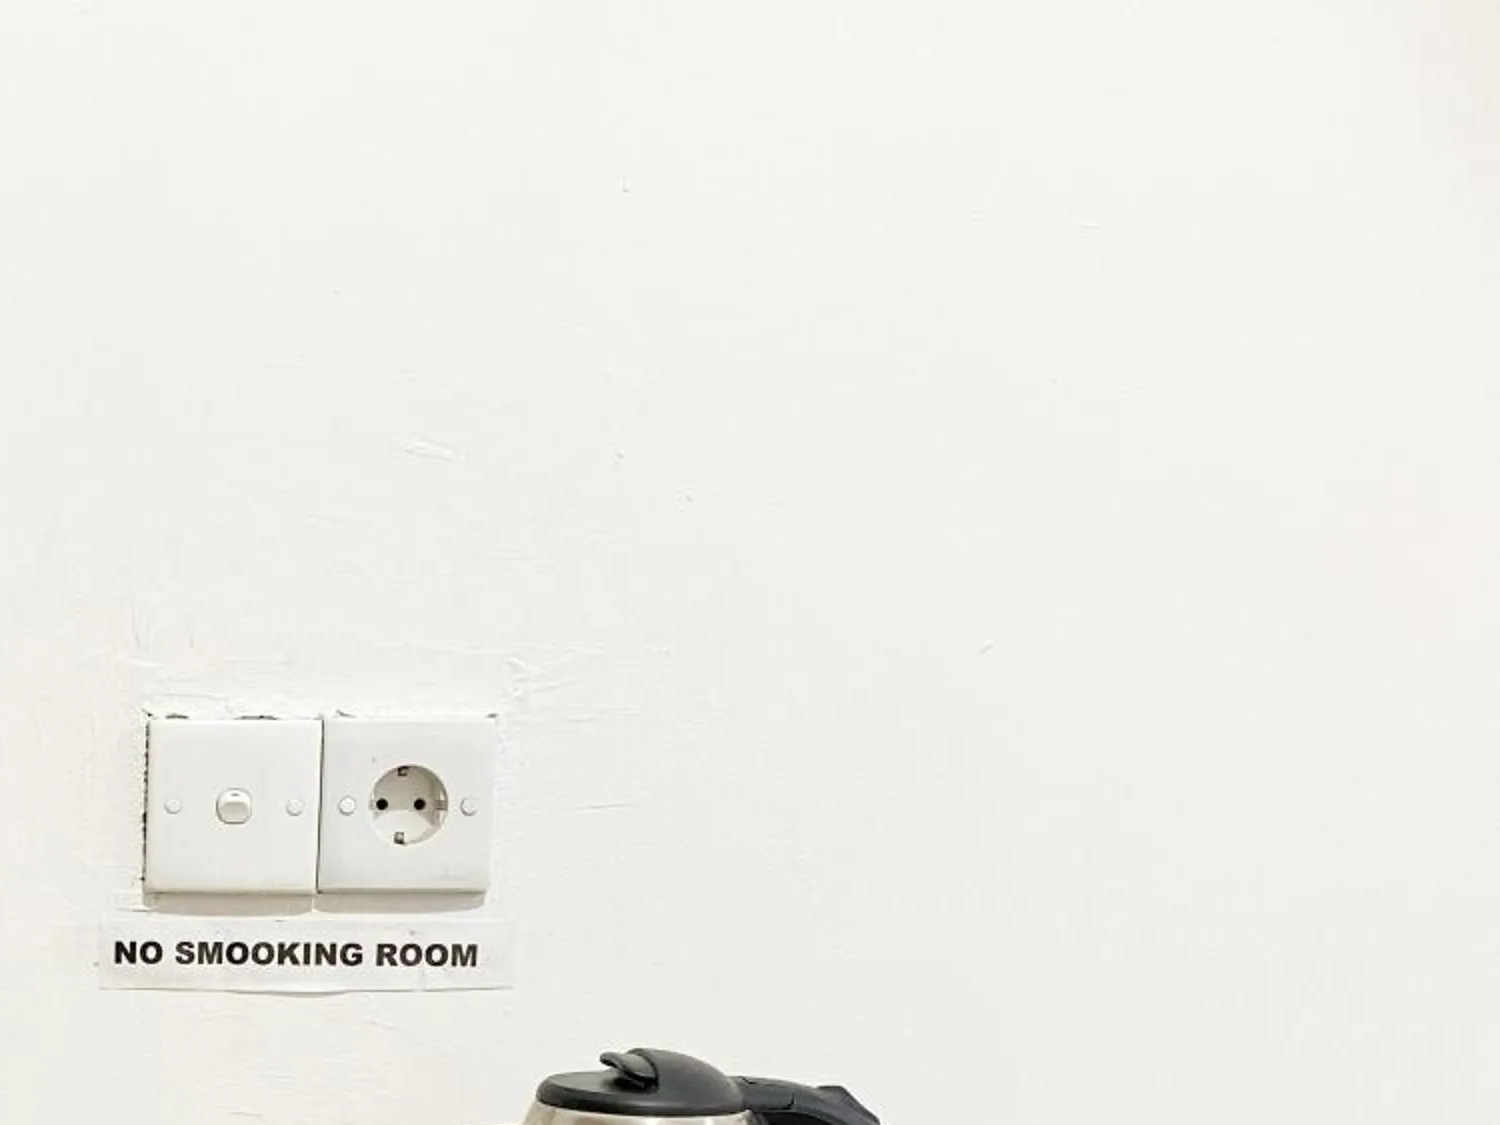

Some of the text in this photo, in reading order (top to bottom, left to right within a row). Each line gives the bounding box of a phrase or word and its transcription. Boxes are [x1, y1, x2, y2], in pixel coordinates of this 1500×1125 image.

[114, 941, 479, 967] NO SMOOKING ROOM
